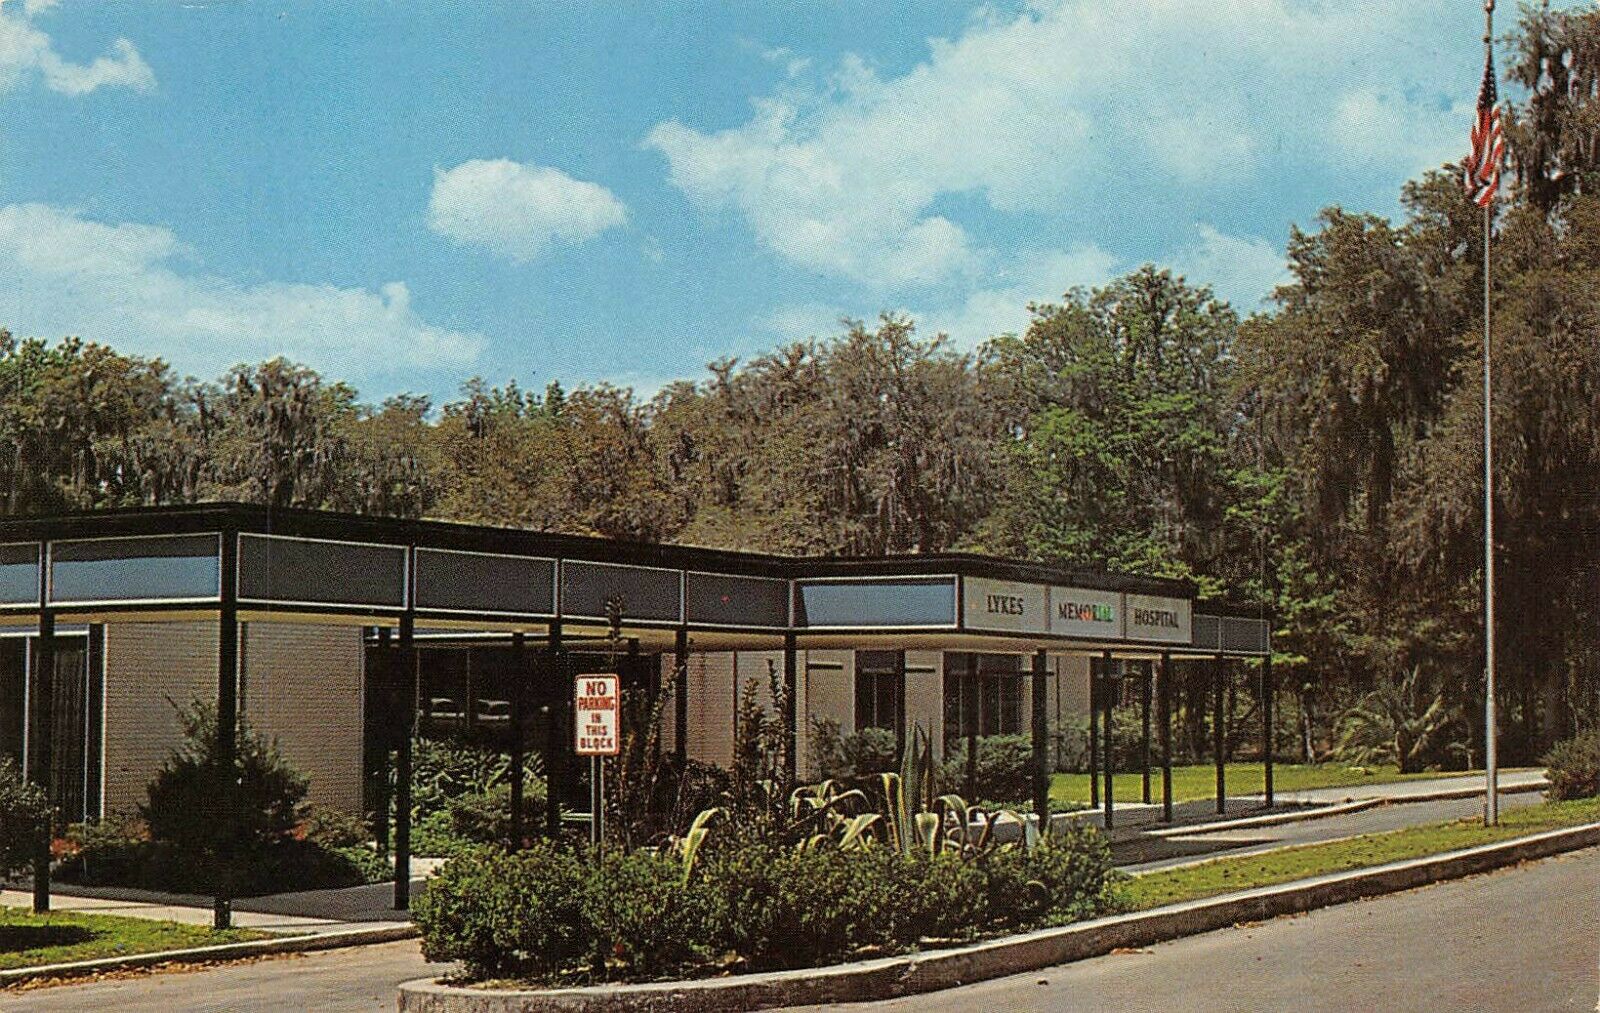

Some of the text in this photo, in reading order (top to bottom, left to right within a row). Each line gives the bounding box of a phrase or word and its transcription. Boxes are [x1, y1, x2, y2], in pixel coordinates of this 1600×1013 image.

[987, 595, 1024, 615] LYKES
[1134, 608, 1179, 628] HOSPITAL
[586, 681, 606, 696] NO
[579, 697, 614, 711] PARKING
[591, 713, 602, 723] IN
[586, 725, 607, 736] THIS
[580, 737, 613, 750] BLOCK
